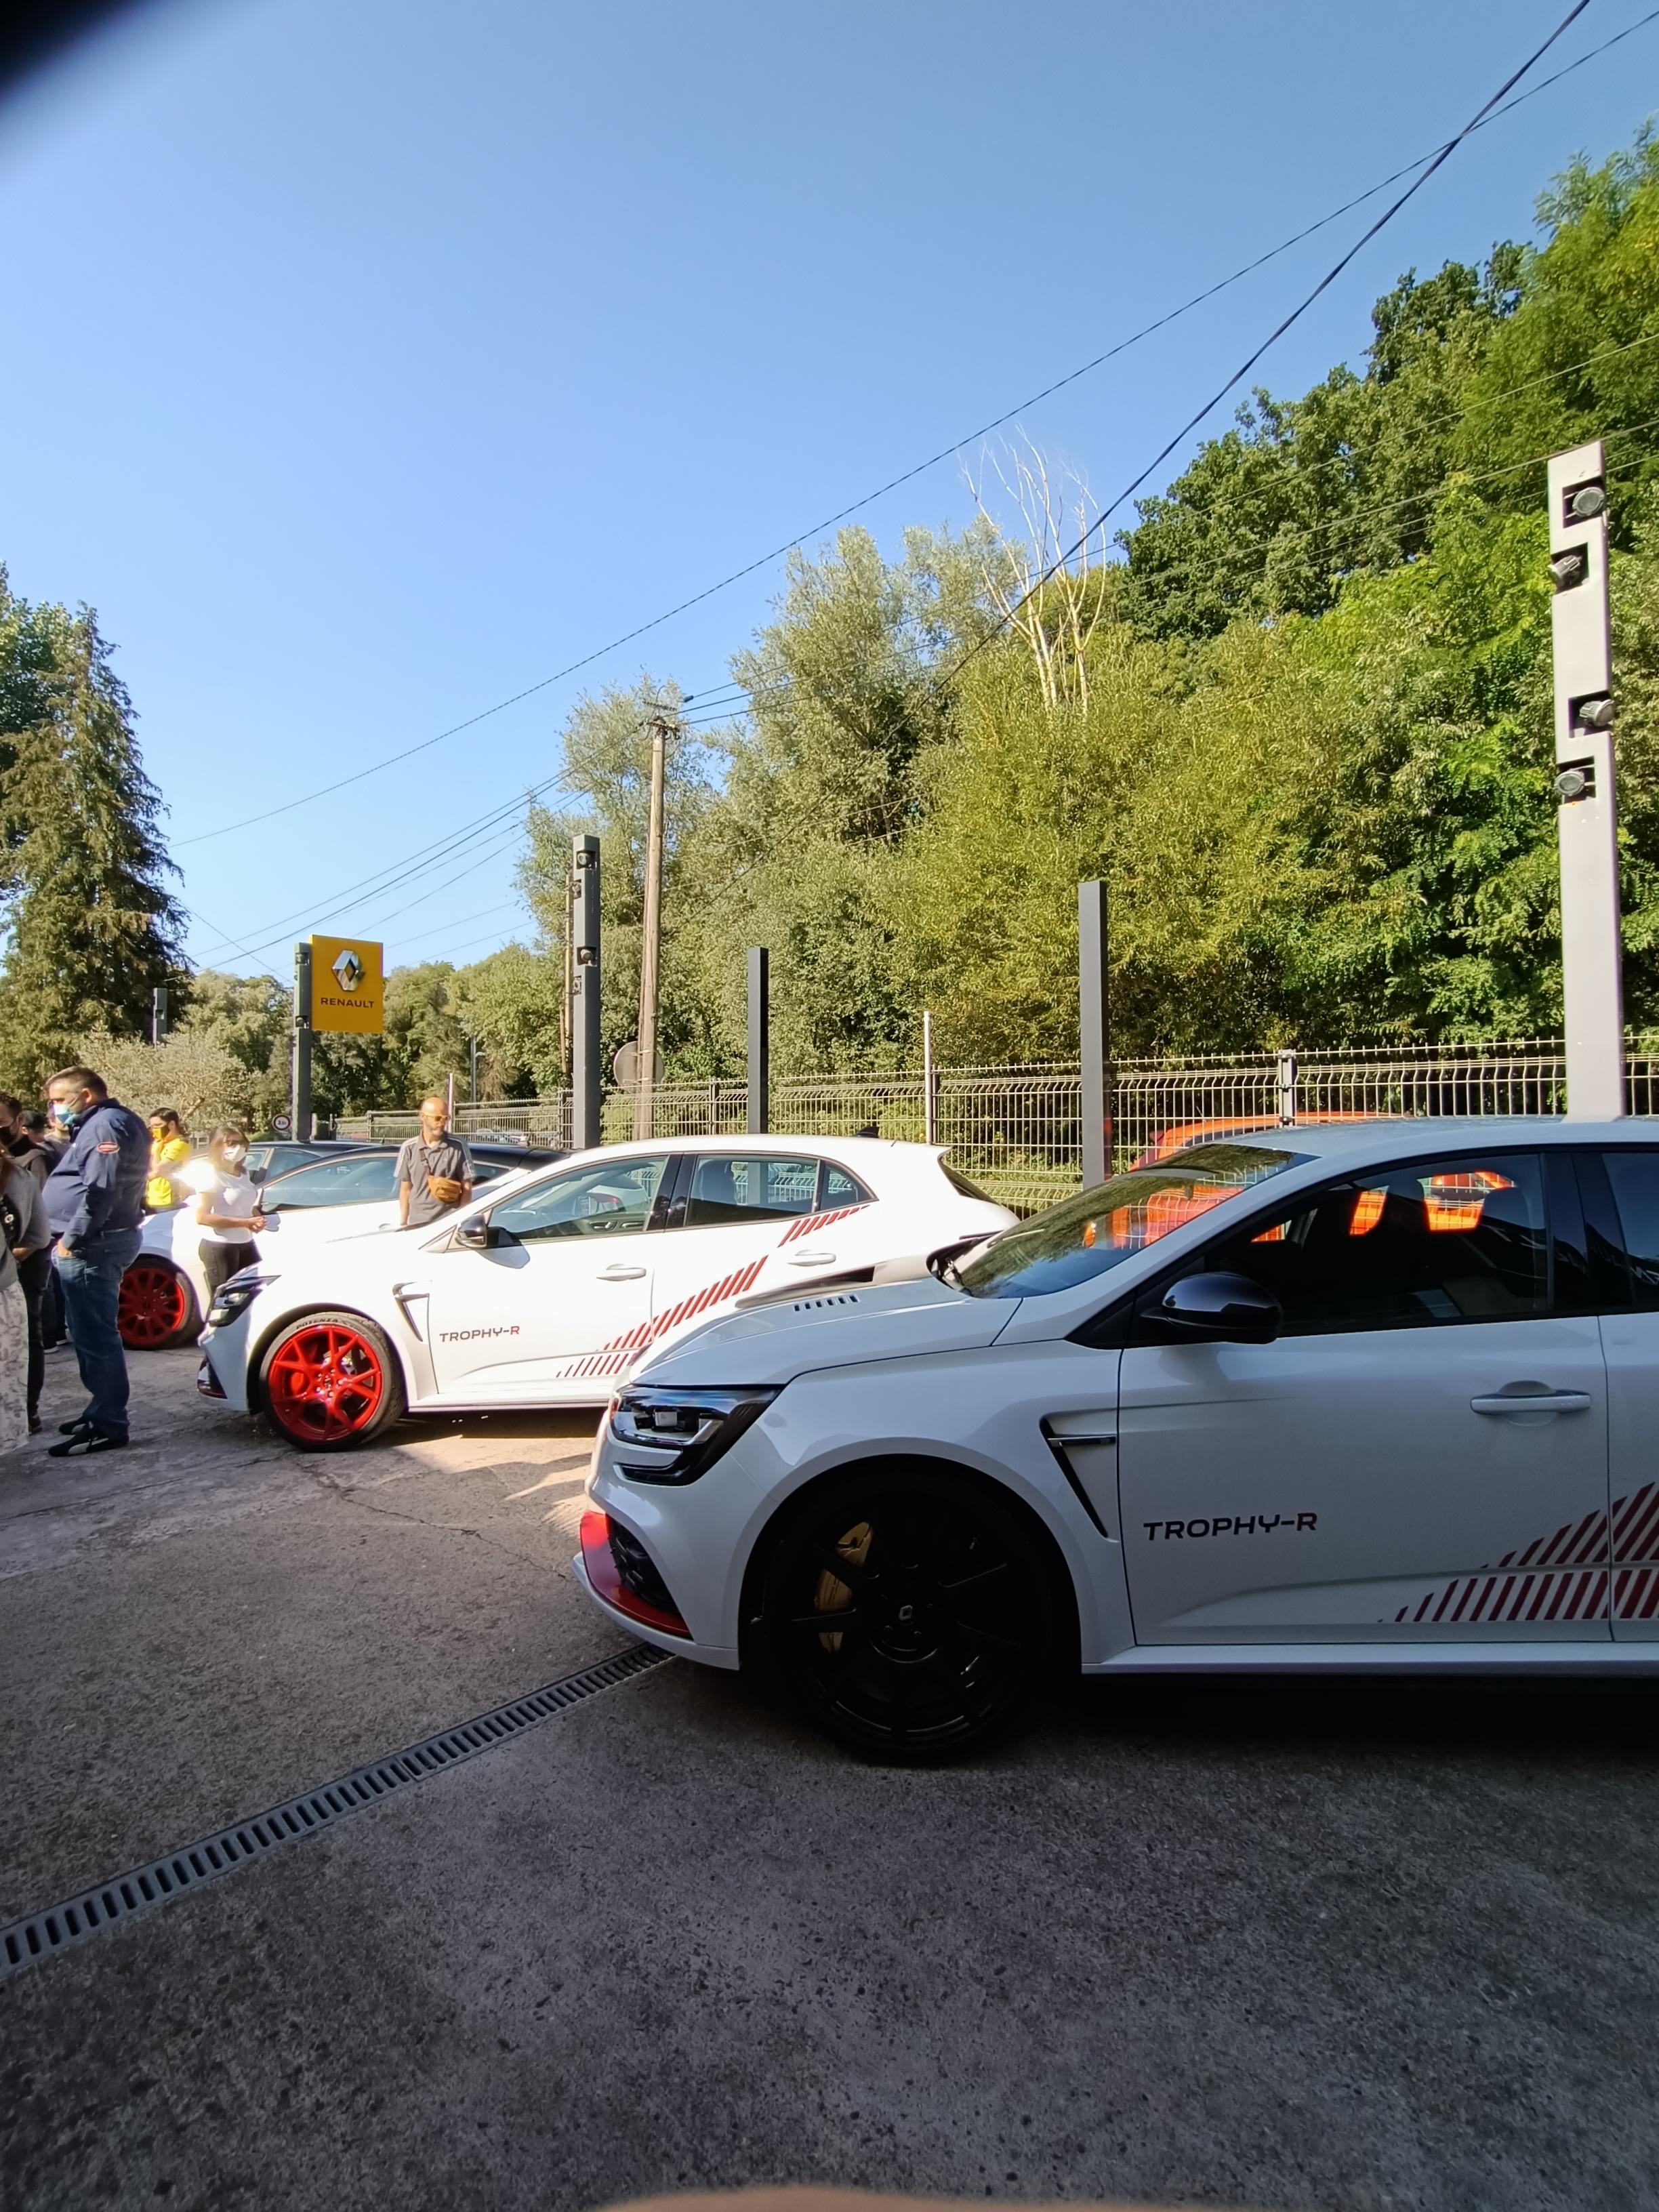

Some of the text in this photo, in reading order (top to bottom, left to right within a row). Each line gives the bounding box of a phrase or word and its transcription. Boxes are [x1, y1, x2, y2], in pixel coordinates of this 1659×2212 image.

[321, 997, 375, 1008] RENAULT
[439, 1326, 520, 1343] TROPHY-R
[1143, 1513, 1317, 1540] TROPHY-R
